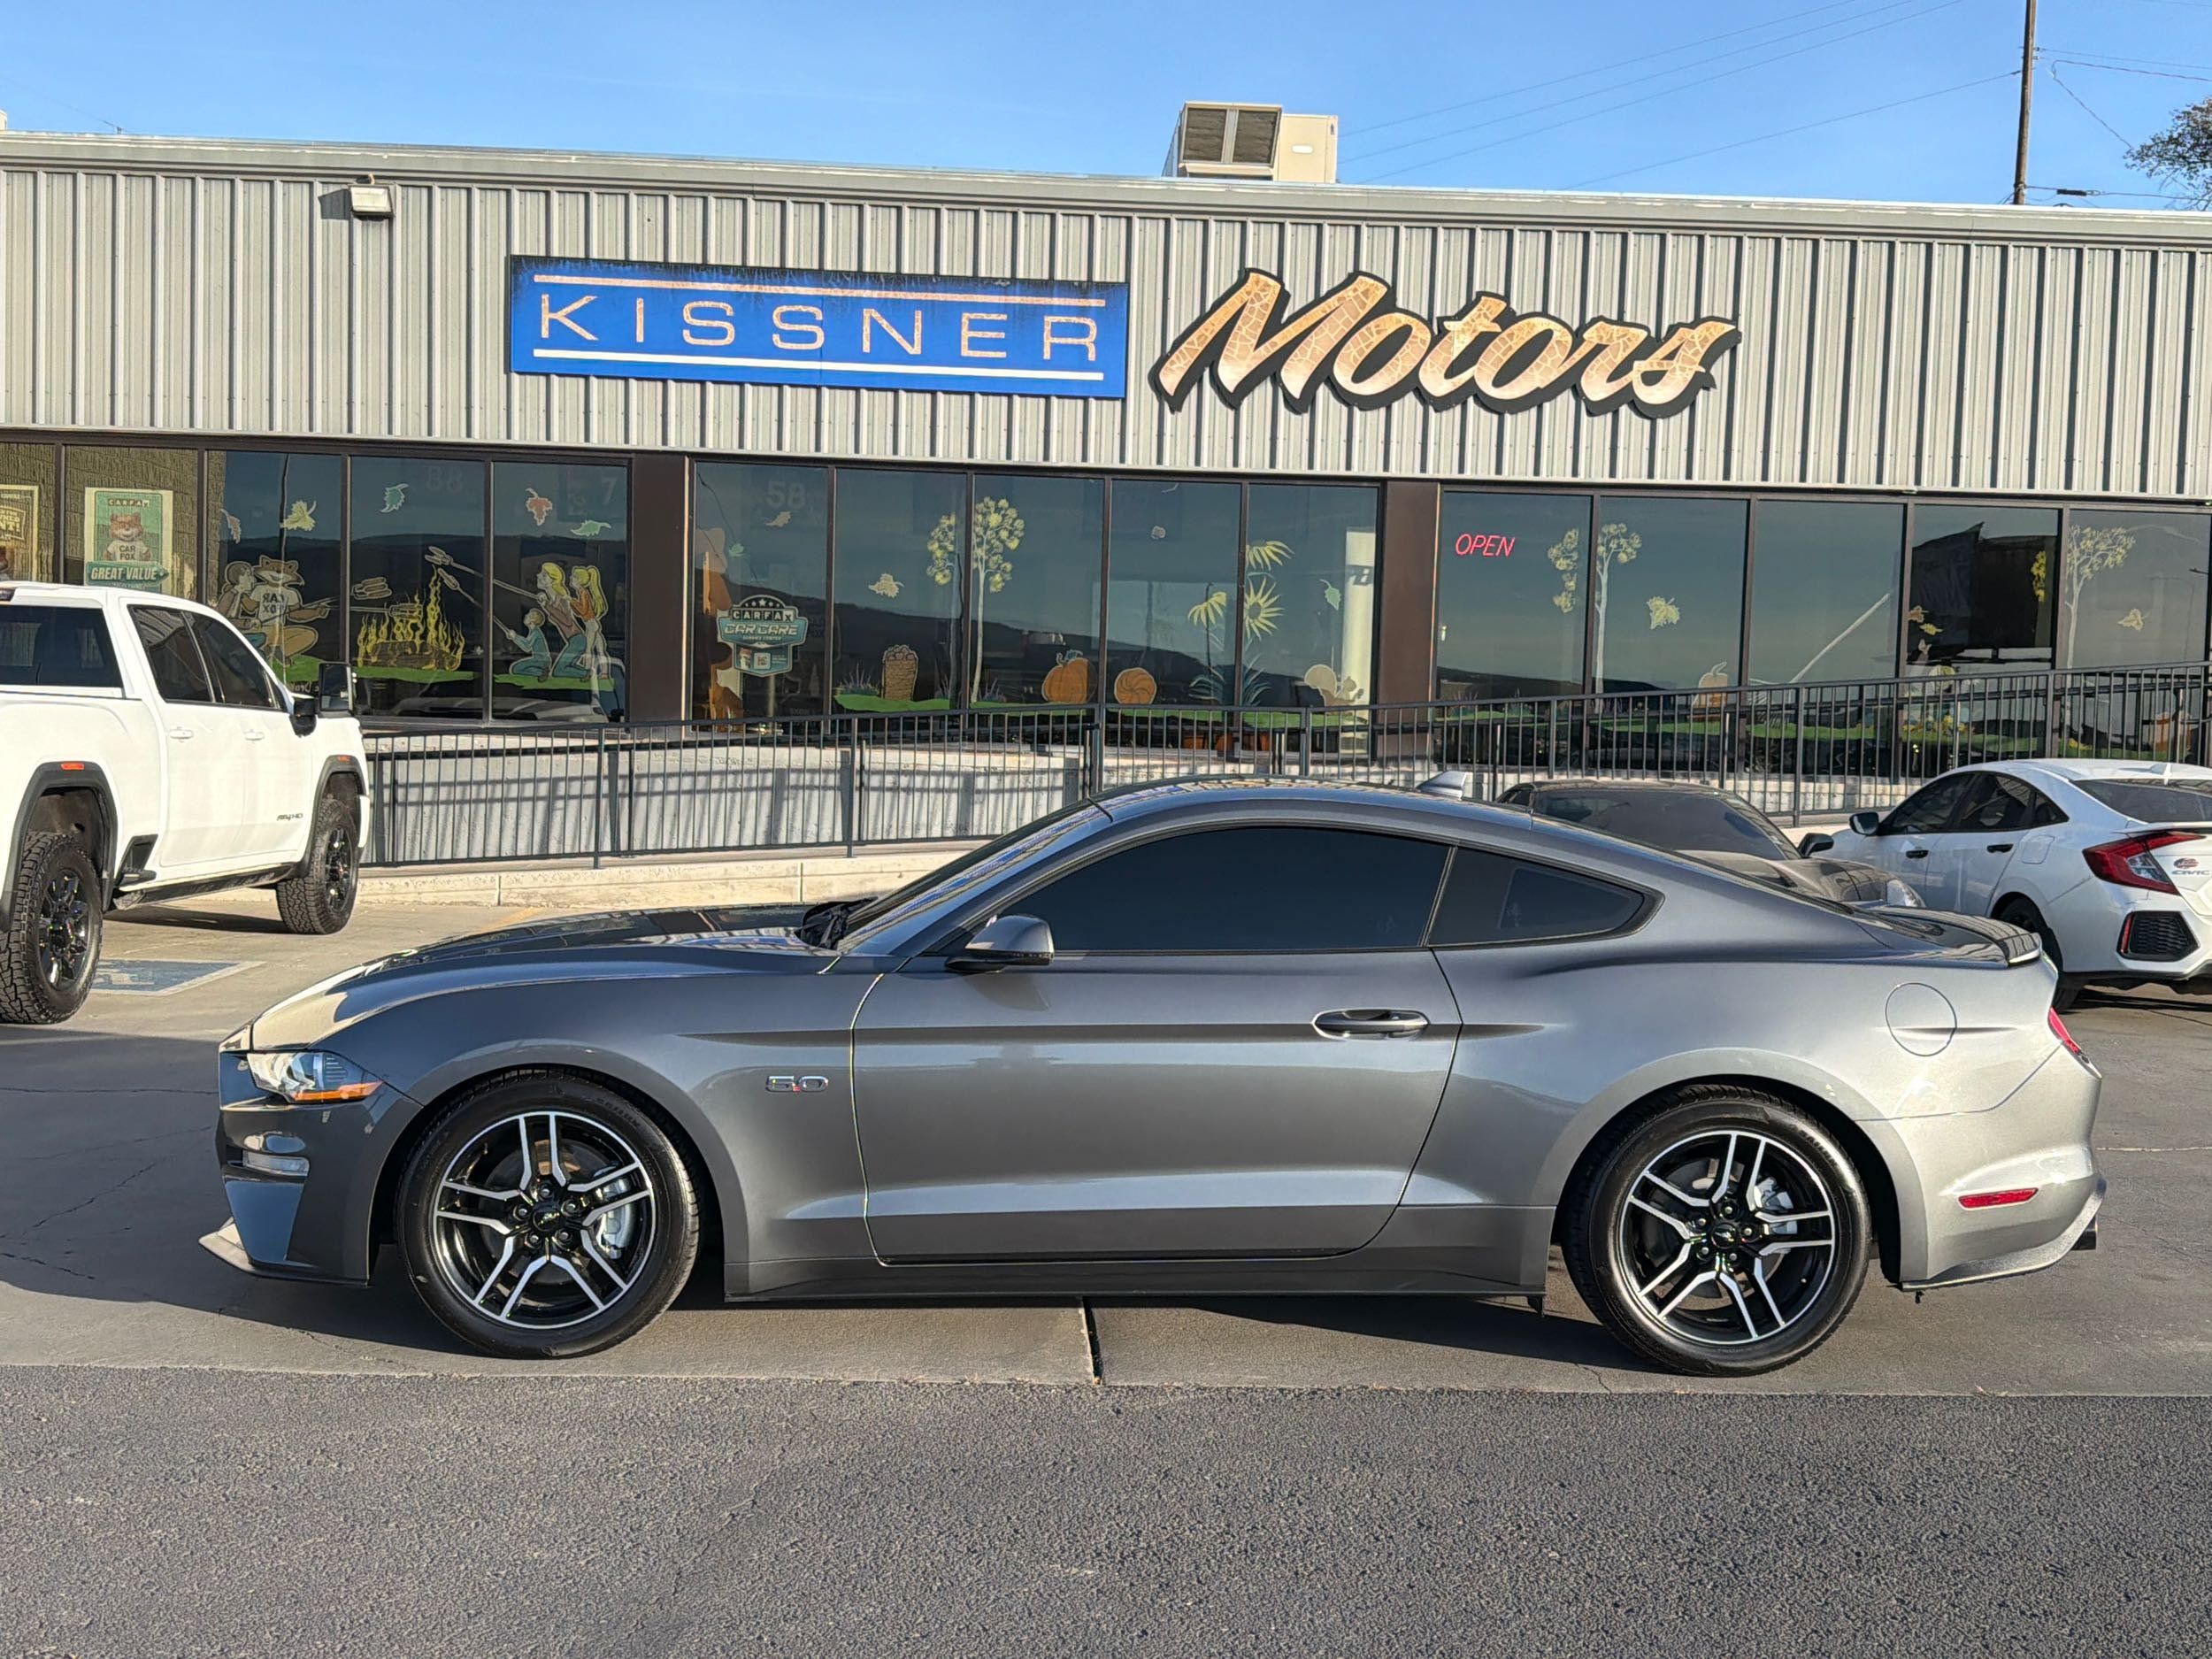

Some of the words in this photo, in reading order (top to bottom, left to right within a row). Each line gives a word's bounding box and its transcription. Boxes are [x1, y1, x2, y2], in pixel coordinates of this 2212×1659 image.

[541, 293, 1098, 362] KISSNER
[1153, 269, 1740, 412] Motors
[1455, 534, 1516, 557] OPEN
[90, 566, 123, 580] GREAT
[126, 566, 157, 580] VALUE
[733, 611, 793, 622] CARFAX
[724, 623, 757, 635] CAR
[757, 623, 799, 635] CARE
[765, 1075, 829, 1093] 5.0
